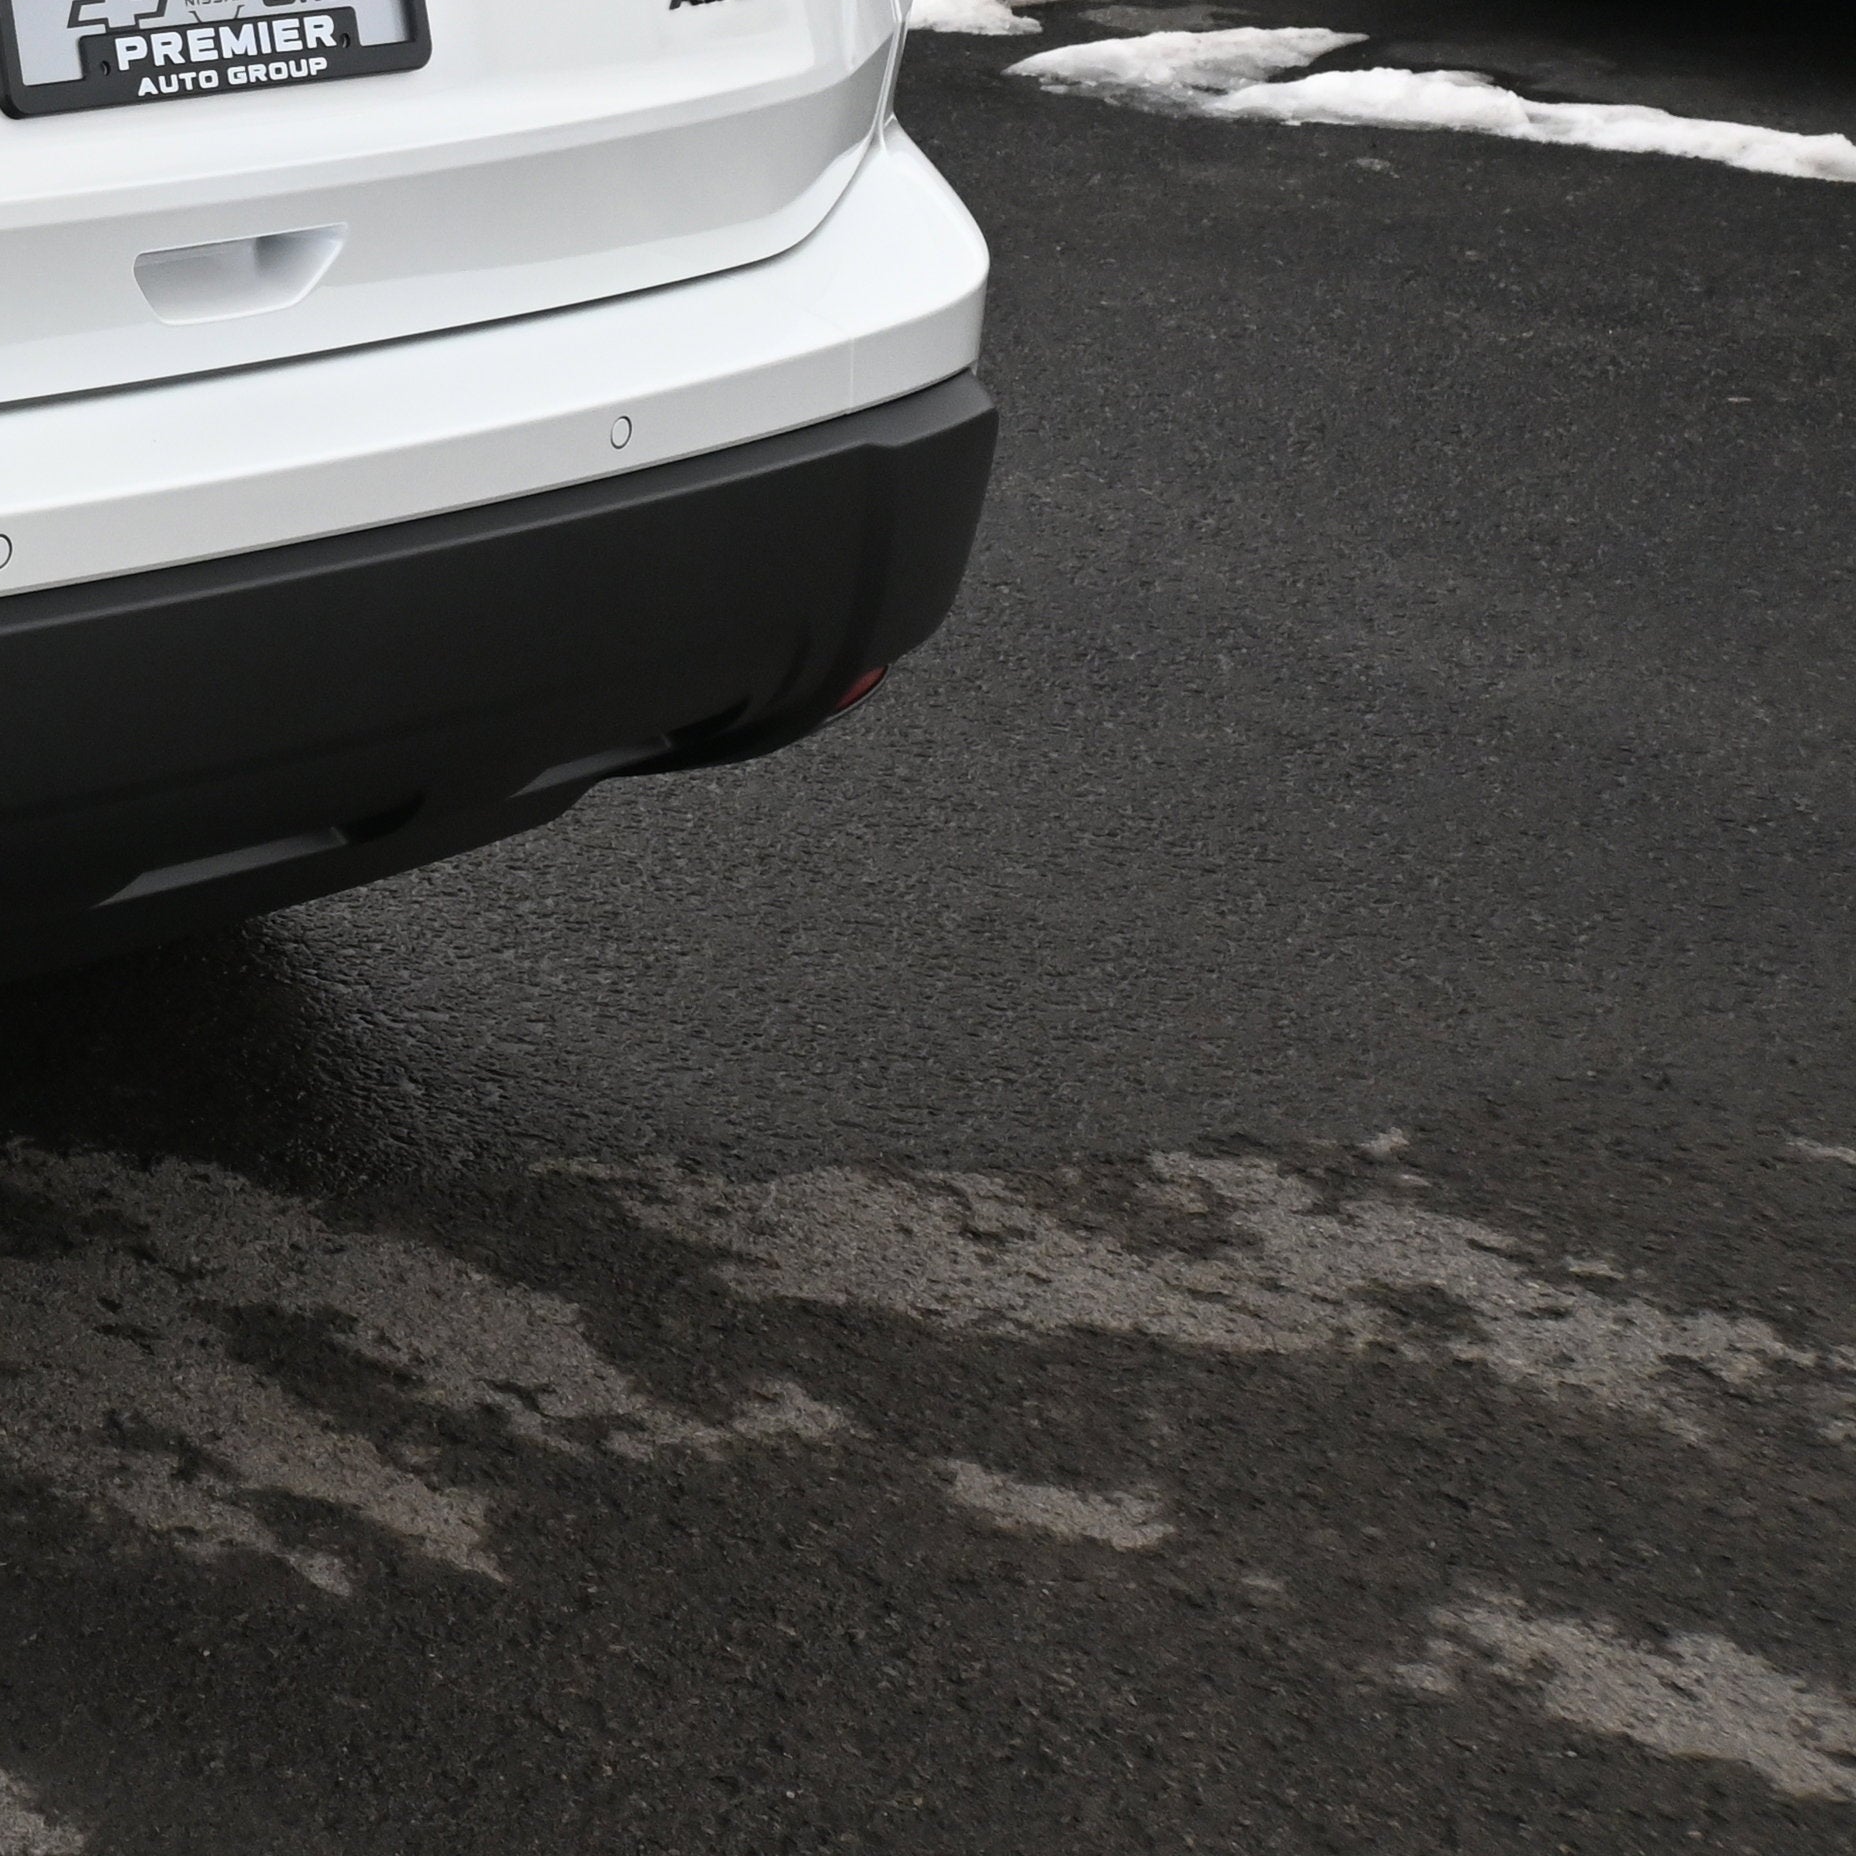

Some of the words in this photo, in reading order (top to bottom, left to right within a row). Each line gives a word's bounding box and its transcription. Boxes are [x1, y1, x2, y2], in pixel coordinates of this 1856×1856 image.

[115, 14, 337, 72] PREMIER
[137, 72, 221, 96] AUTO
[229, 56, 329, 84] GROUP
